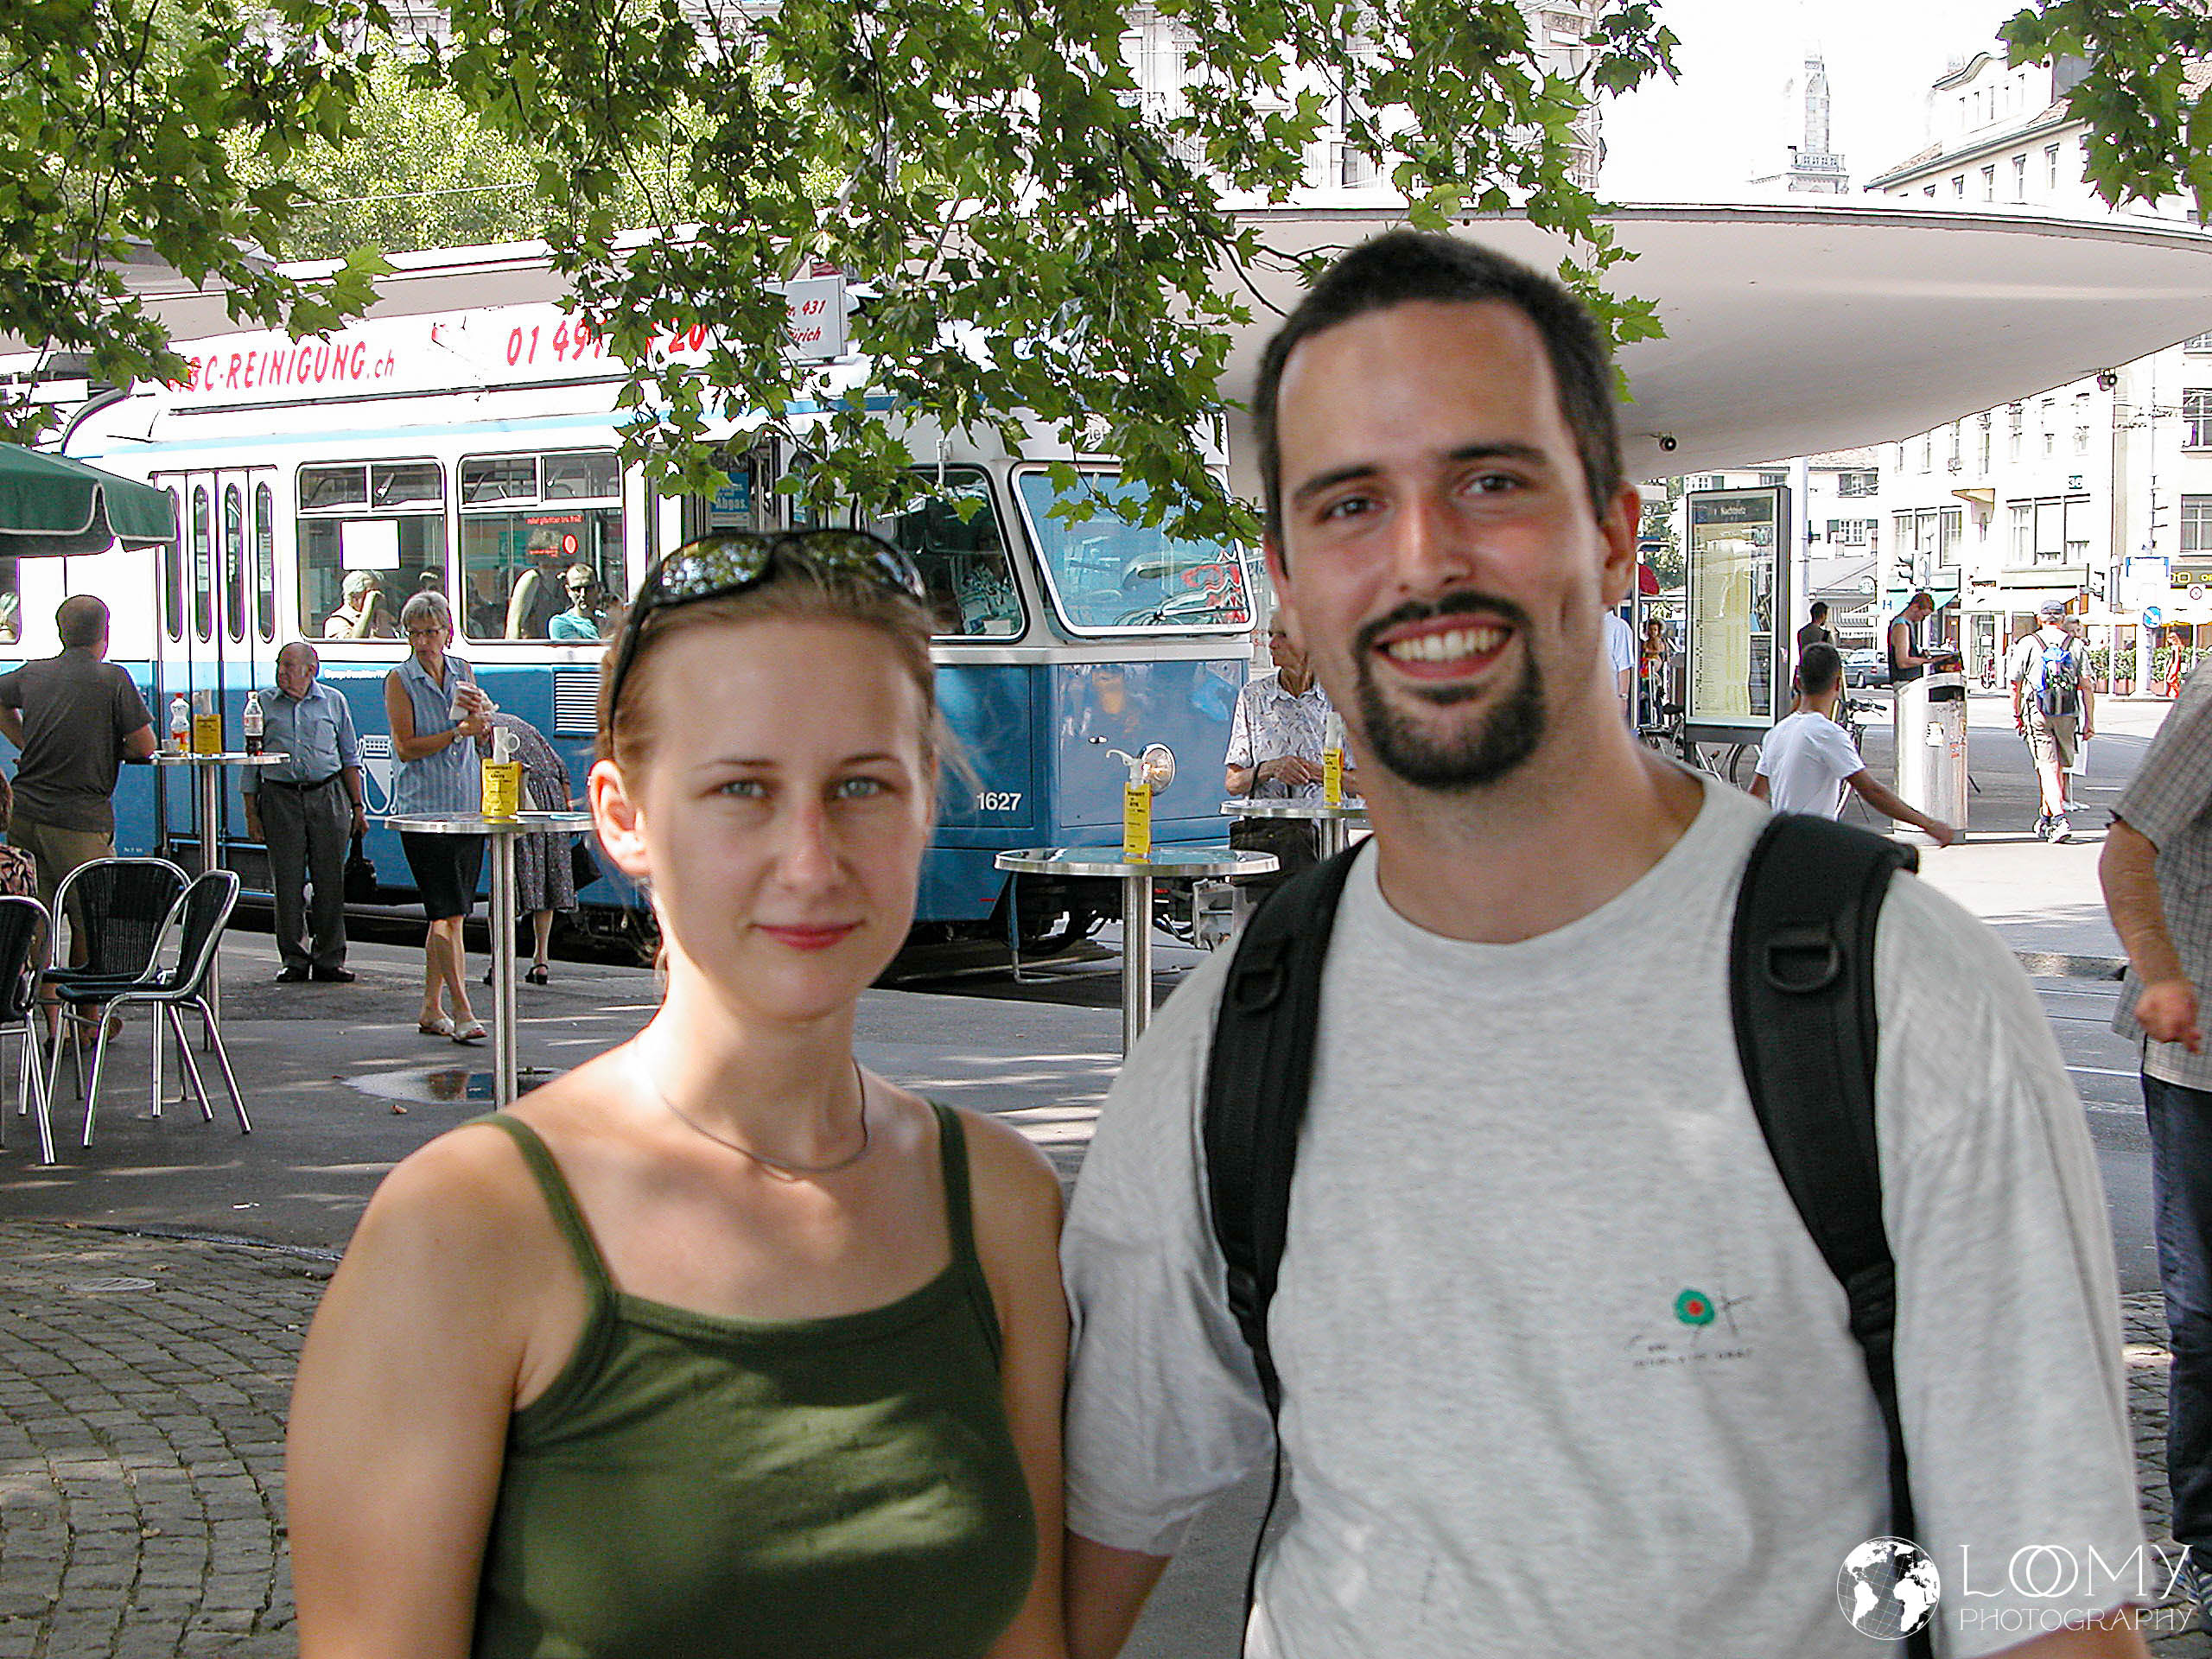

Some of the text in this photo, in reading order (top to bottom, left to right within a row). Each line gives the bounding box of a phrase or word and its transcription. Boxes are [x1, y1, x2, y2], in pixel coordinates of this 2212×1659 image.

[801, 299, 827, 316] 431
[168, 340, 395, 393] BC-REINIGUNG.ch
[506, 326, 540, 366] 01
[976, 791, 1022, 811] 1627
